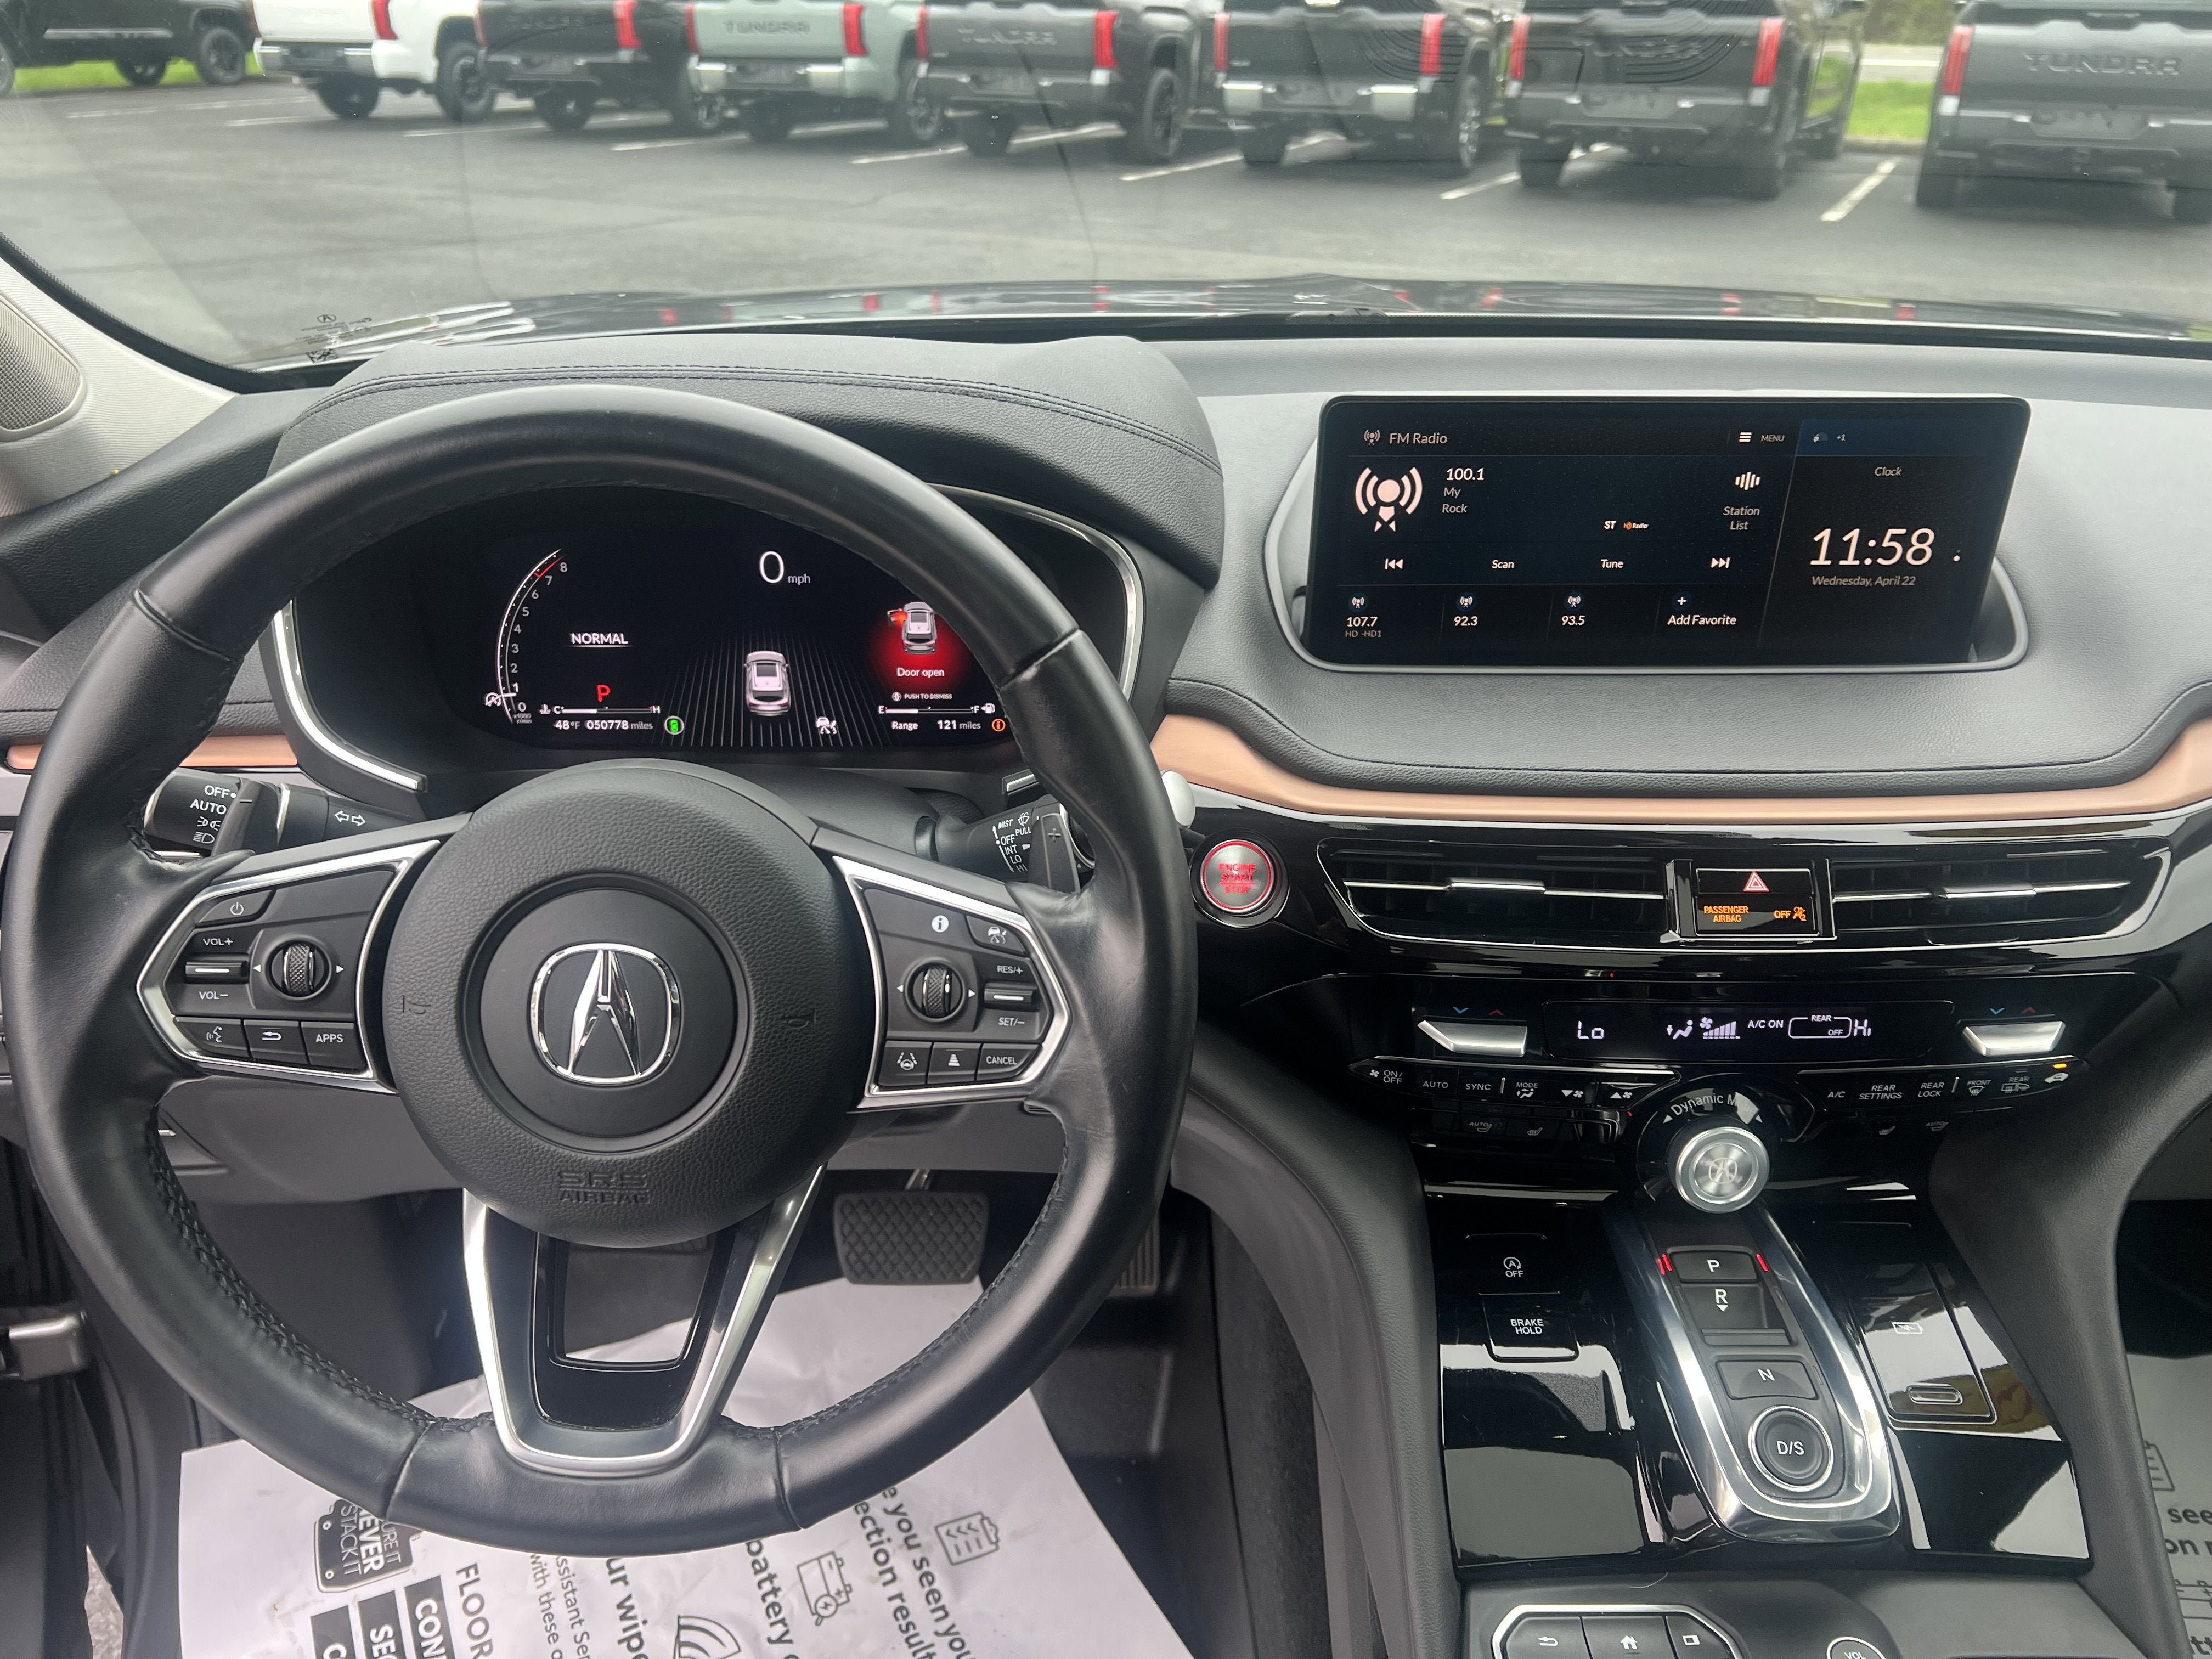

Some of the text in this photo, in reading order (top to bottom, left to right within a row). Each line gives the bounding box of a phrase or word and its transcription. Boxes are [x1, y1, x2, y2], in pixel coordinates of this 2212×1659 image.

[1389, 432, 1447, 444] FM Radio
[1446, 468, 1485, 481] 100.1
[1875, 466, 1902, 476] Clock
[1443, 487, 1461, 499] My
[1442, 503, 1468, 514] Rock
[1723, 506, 1760, 516] Station
[1604, 521, 1617, 529] ST
[1730, 521, 1748, 530] List
[1810, 528, 1935, 566] 11:58
[560, 562, 568, 573] 8
[759, 551, 811, 585] 0 mph
[1492, 560, 1514, 569] Scan
[1601, 559, 1624, 568] Tune
[545, 576, 552, 585] 7
[1812, 576, 1916, 587] Wednesday, April 22
[532, 590, 539, 599] 6
[522, 607, 529, 617] 5
[1347, 617, 1378, 627] 107.7
[1454, 616, 1478, 626] 92.3
[1561, 616, 1585, 625] 93.5
[1667, 615, 1737, 625] Add Favorite
[514, 624, 522, 634] 4
[570, 633, 628, 644] NORMAL
[512, 644, 519, 653] 3
[511, 663, 518, 673] 2
[897, 668, 945, 679] Door open
[513, 683, 518, 692] 1
[596, 685, 611, 702] P
[518, 702, 526, 712] 0
[878, 706, 884, 714] E
[974, 706, 980, 714] F
[585, 720, 629, 730] 050778
[631, 720, 653, 730] miles
[891, 720, 981, 731] Range 121 miles
[205, 785, 229, 799] OFF
[190, 799, 227, 815] AUTO
[998, 819, 1013, 830] MIST
[1015, 826, 1031, 837] PULL
[1001, 834, 1015, 846] OFF
[1004, 844, 1018, 855] INT
[1009, 854, 1023, 864] LO
[1016, 864, 1028, 873] HI
[1218, 862, 1256, 872] ENGINE
[1221, 873, 1253, 882] START
[1223, 885, 1251, 894] STOP
[1703, 906, 1749, 914] PASSENGER
[1713, 910, 1791, 923] AIRBAG OFF
[1747, 1020, 1784, 1029] A/C ON
[1577, 1020, 1605, 1040] Lo
[315, 1034, 343, 1044] APPS
[986, 1056, 1017, 1066] CANCEL
[1383, 1070, 1403, 1078] ON/
[1383, 1076, 1403, 1084] OFF
[1423, 1081, 1449, 1089] AUTO
[1465, 1083, 1491, 1091] SYNC
[1859, 1091, 1903, 1100] SETTINGS
[1671, 1093, 1724, 1116] Dynamic
[559, 1191, 650, 1204] AIRBAG
[1707, 1259, 1720, 1273] P
[1715, 1288, 1729, 1305] R
[1510, 1318, 1544, 1327] BRAKE
[1515, 1327, 1543, 1335] HOLD
[1757, 1368, 1776, 1381] N
[1776, 1440, 1805, 1456] D/S
[338, 1504, 362, 1575] STACK IT
[386, 1551, 402, 1564] IT
[884, 1504, 921, 1551] you
[913, 1556, 950, 1623] seen
[538, 1592, 560, 1645] these
[415, 1598, 447, 1659] CON
